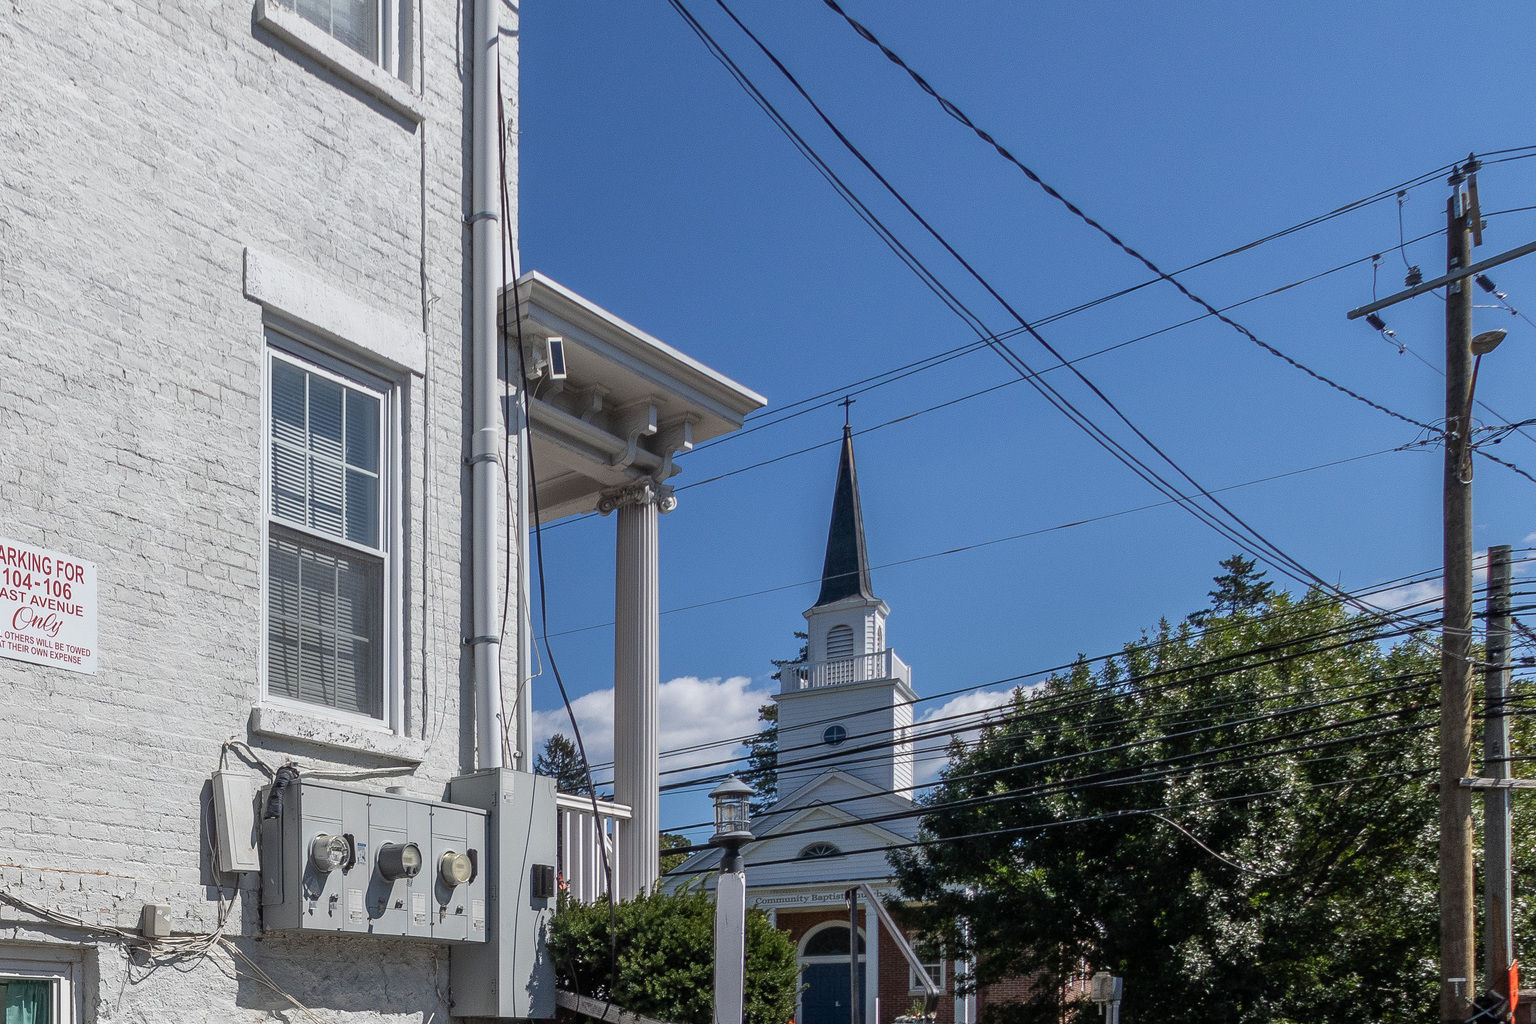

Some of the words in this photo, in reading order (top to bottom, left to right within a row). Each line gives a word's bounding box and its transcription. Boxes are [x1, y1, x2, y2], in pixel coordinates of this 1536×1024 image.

[3, 568, 72, 600] 104-106
[56, 559, 85, 585] FOR
[30, 594, 84, 617] AVENUE
[12, 606, 63, 638] Only
[4, 630, 35, 645] OTHERS
[36, 637, 53, 649] WILL
[55, 641, 64, 652] BE
[66, 644, 91, 657] TOWED
[7, 641, 29, 654] THEIR
[31, 646, 48, 658] OWN
[50, 650, 82, 665] EXPENSE
[755, 895, 809, 905] Community
[811, 892, 844, 903] Baptist
